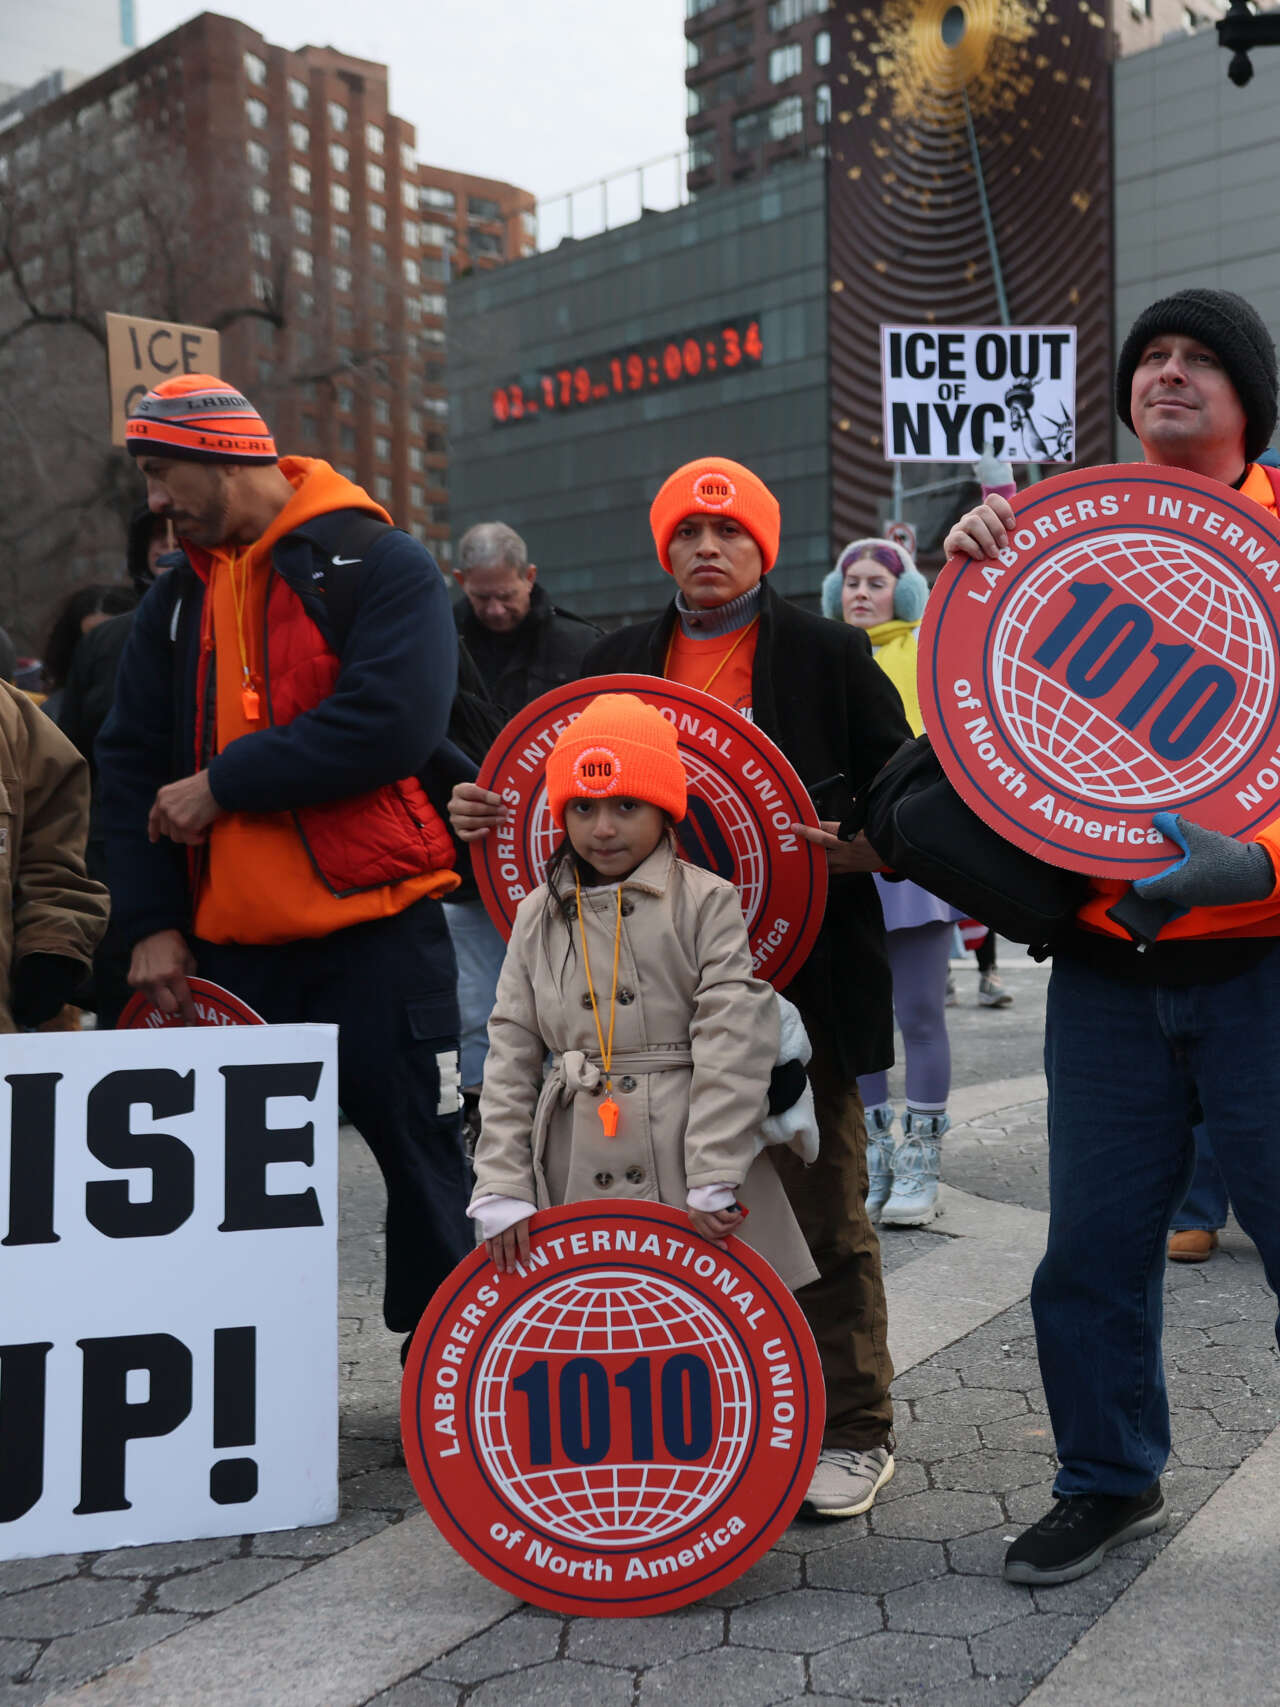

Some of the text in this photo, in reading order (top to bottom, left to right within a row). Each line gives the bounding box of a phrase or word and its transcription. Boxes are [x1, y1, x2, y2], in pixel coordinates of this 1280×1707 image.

[129, 327, 202, 374] ICE
[890, 332, 1070, 381] ICE OUT
[938, 383, 966, 401] OF
[892, 402, 1006, 457] NYC
[701, 485, 728, 496] 1010
[968, 494, 1131, 604] LABORERS'
[1032, 581, 1237, 762] 1010
[581, 763, 612, 777] 1010
[954, 679, 1164, 845] of North America
[742, 759, 799, 852] UNION
[752, 917, 790, 971] erica
[434, 1230, 795, 1458] LABORERS' INTERNATIONAL UNION
[513, 1353, 713, 1466] 1010
[489, 1514, 746, 1582] of North America
